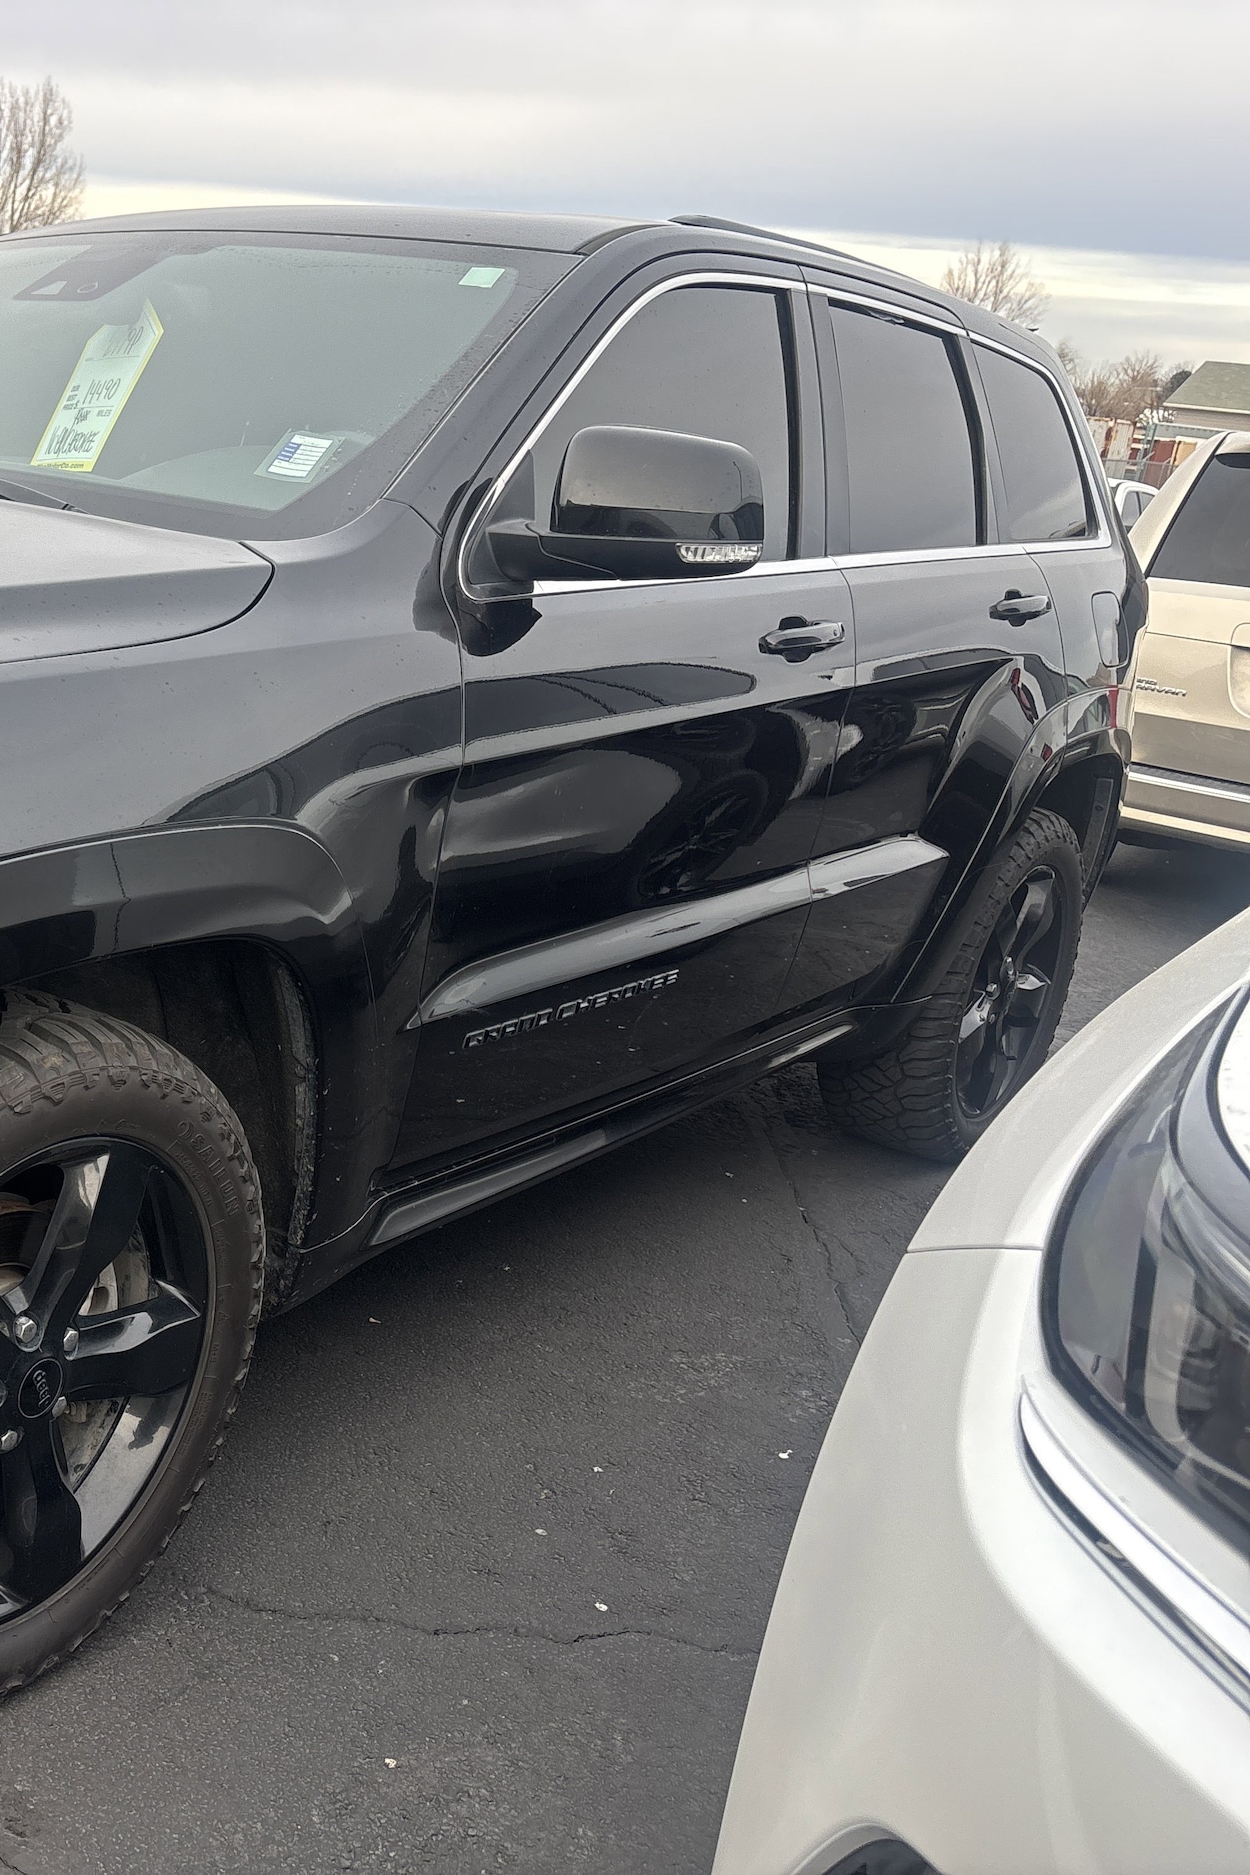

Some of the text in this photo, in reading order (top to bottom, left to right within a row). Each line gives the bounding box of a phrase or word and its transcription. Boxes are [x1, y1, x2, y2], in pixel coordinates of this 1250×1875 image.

[82, 377, 121, 405] 14490
[462, 969, 679, 1049] GRAND CHEROKEE
[190, 1133, 240, 1216] SAILUN
[32, 1369, 51, 1407] Jeep
